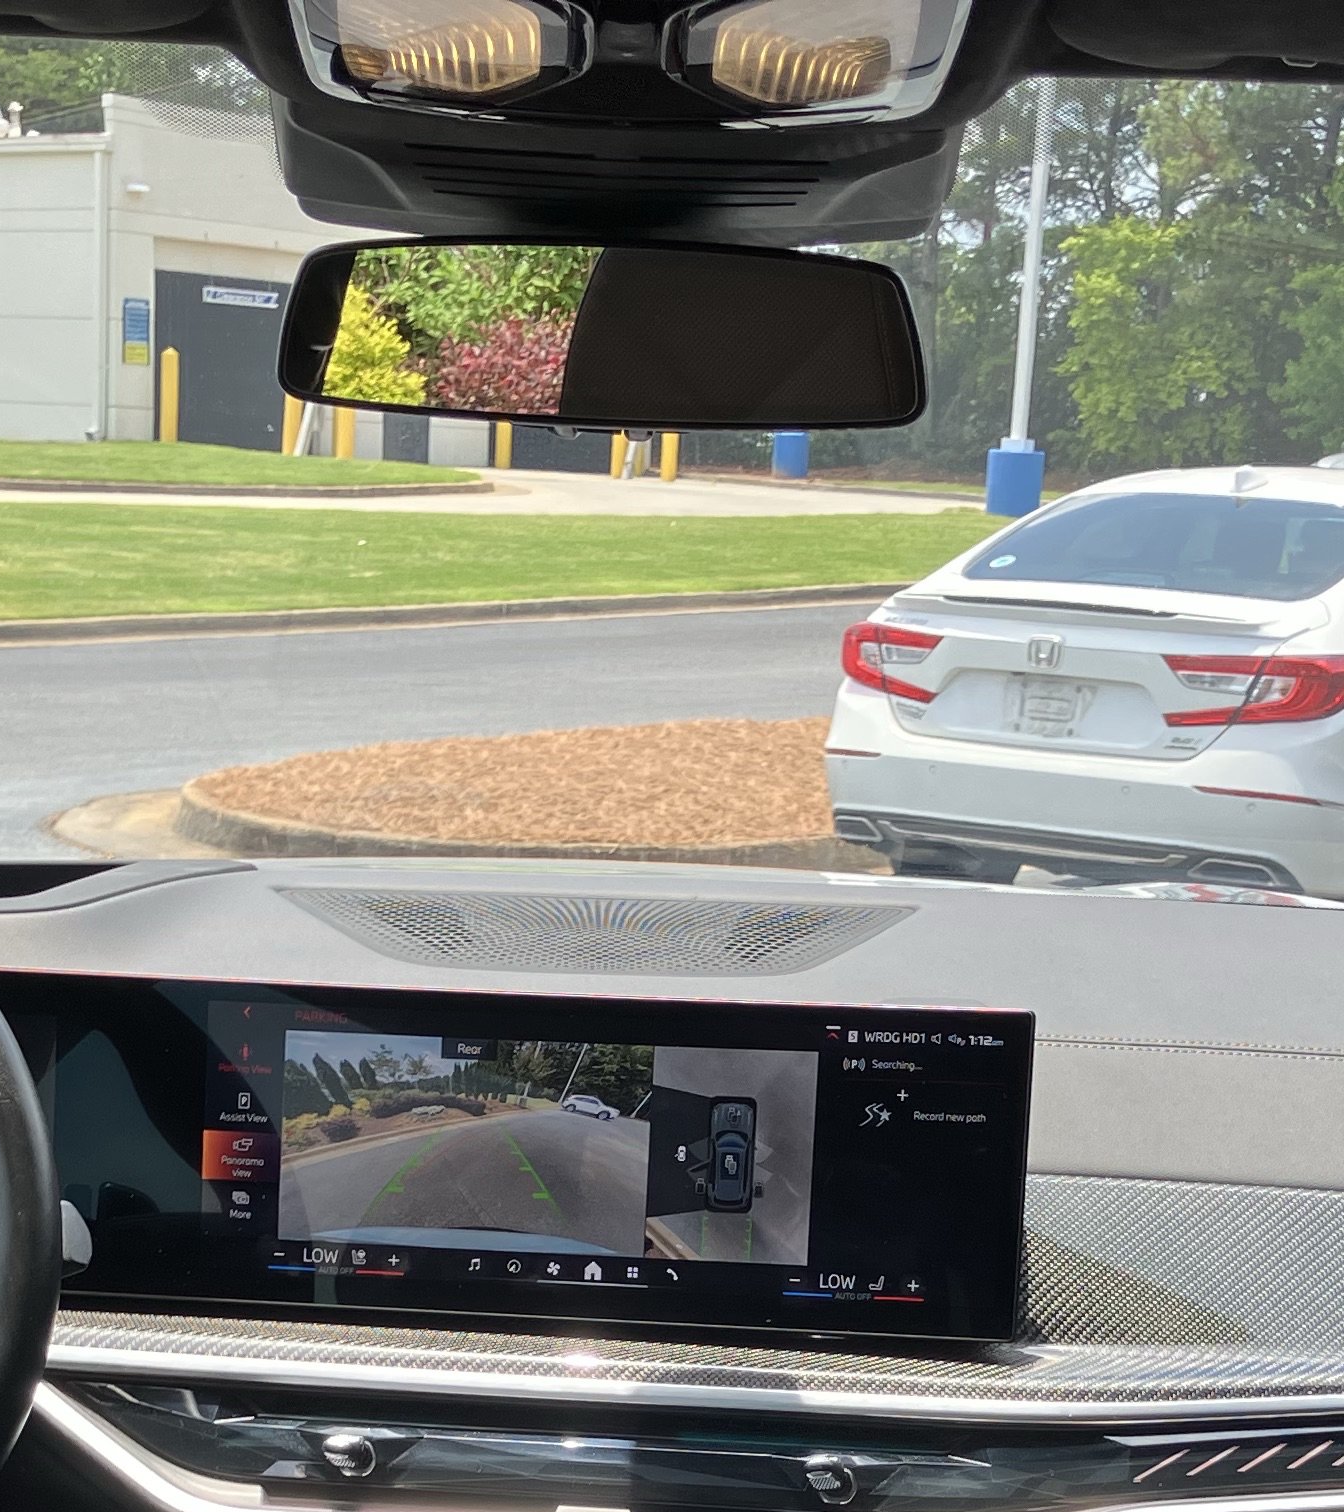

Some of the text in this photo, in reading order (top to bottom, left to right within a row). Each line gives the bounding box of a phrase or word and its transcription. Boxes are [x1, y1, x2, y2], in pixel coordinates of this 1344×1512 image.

[295, 1010, 349, 1024] PARKING
[864, 1031, 901, 1044] WRDG
[902, 1032, 926, 1044] HD1
[457, 1042, 483, 1055] Rear
[219, 1111, 269, 1124] Assist View
[913, 1110, 987, 1124] Record new path
[221, 1155, 265, 1168] Panorama
[229, 1208, 252, 1220] More
[302, 1247, 340, 1265] LOW
[818, 1273, 857, 1290] LOW
